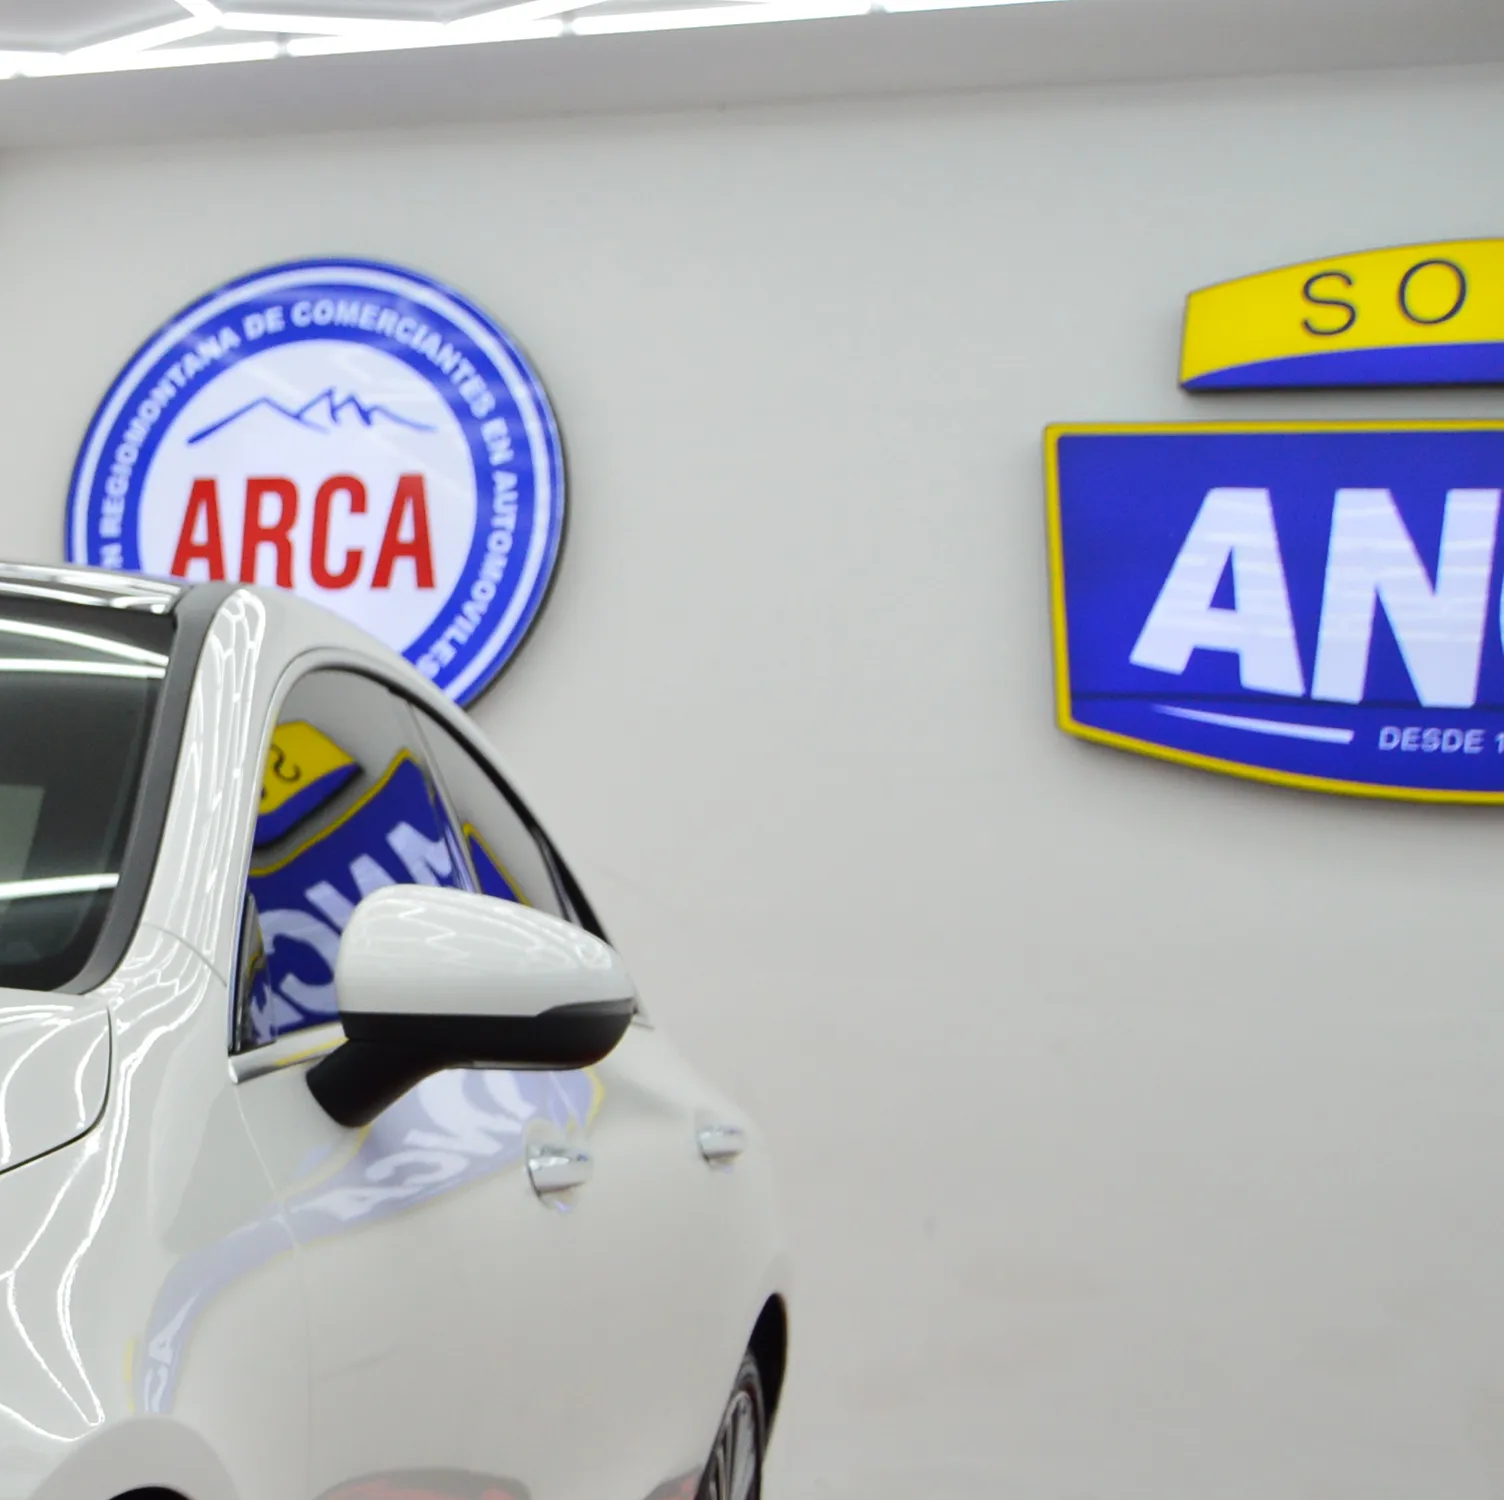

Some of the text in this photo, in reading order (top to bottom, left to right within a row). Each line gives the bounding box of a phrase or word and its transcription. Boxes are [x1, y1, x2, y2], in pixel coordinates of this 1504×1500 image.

[244, 306, 285, 341] DE
[292, 299, 494, 420] COMERCIANTES
[481, 417, 515, 465] EN
[170, 473, 436, 592] ARCA
[416, 471, 519, 681] AUTOMOVILES
[1129, 486, 1504, 708] AN
[1378, 725, 1486, 754] DESDE
